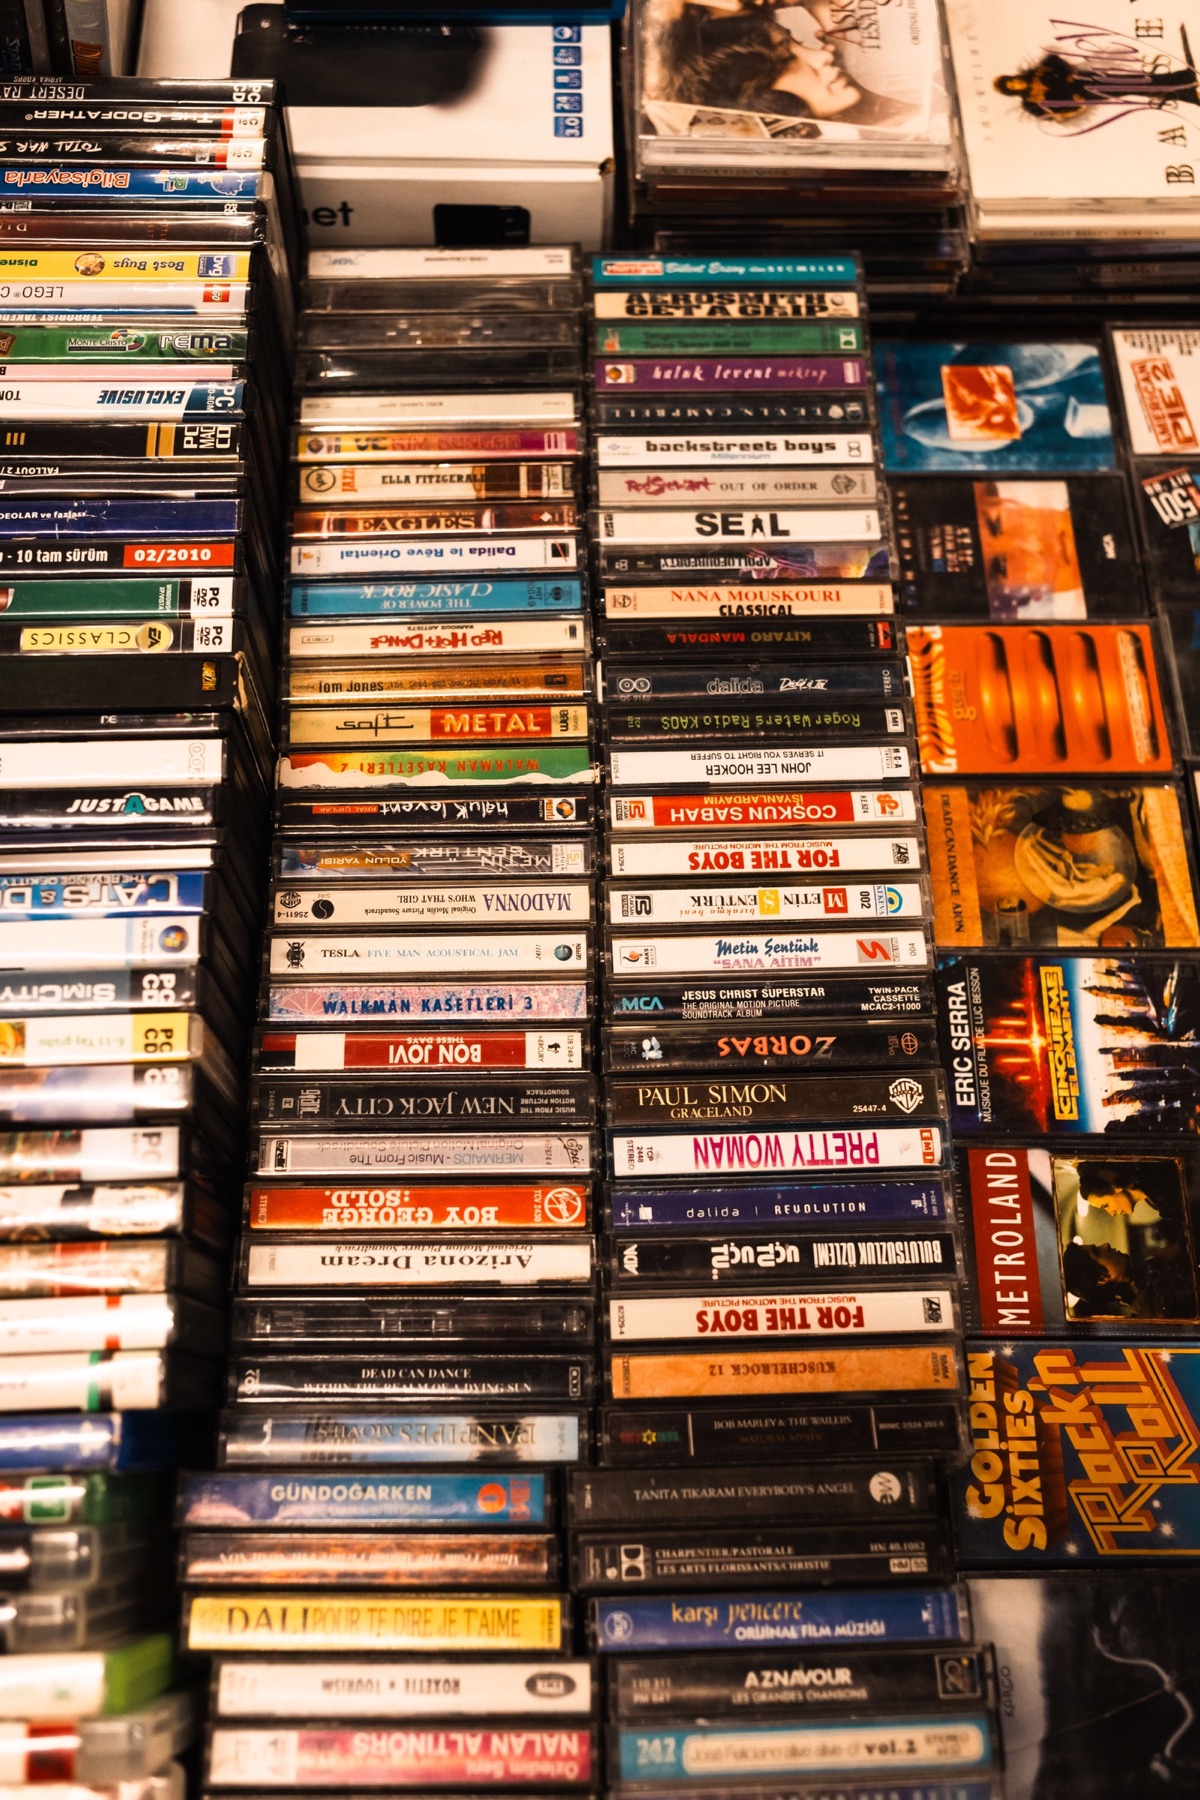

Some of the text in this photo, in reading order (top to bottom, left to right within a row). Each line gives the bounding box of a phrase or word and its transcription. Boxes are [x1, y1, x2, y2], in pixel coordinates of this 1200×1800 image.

[17, 141, 102, 153] TOTAL WAR
[4, 169, 131, 188] Bilgisayarla
[113, 260, 185, 272] Best Buys
[625, 292, 827, 306] AEROSMITH
[160, 334, 231, 350] rema
[97, 390, 186, 404] EXCLUSIVE
[215, 386, 236, 408] PC
[1157, 389, 1194, 445] PIE
[183, 426, 200, 449] PC
[215, 426, 231, 449] CD
[645, 439, 837, 454] backstreet boys
[1151, 490, 1200, 526] 501
[356, 516, 476, 532] EAGLES
[17, 550, 33, 563] 10
[36, 549, 62, 563] tam
[66, 549, 108, 563] sürüm
[134, 549, 212, 563] 02/2010
[340, 546, 516, 560] Dalida le Rêve Oriental
[208, 587, 220, 607] PC
[380, 599, 473, 609] THE POWER OF
[671, 589, 842, 602] NANA MOUSKOURI
[719, 604, 795, 617] CLASSICAL
[31, 631, 131, 645] CLASSICS
[148, 627, 162, 649] EA
[212, 626, 223, 646] PC
[666, 630, 812, 644] KITARO MANDALA
[318, 679, 384, 693] Tom Jones
[335, 712, 542, 737] soft METAL
[661, 712, 861, 730] Roger Waters Radio KAOS
[690, 750, 825, 761] IT SERVES YOU RIGHT TO SUFFER
[705, 761, 812, 776] JOHN LEE HOOKER
[670, 803, 837, 823] COŞKUN SABAH
[321, 856, 408, 867] YOLUN YARISI
[688, 848, 841, 871] FOR THE BOYS
[941, 793, 965, 934] DEAD CAN DANCE AION
[60, 874, 121, 886] REVENGE
[397, 894, 477, 904] WHO'S THAT GIRL
[482, 893, 572, 912] MADONNA
[860, 890, 871, 909] 002
[321, 946, 519, 959] TESLA FIVE MAN ACOUSTICAL JAM
[714, 938, 758, 956] Metin
[142, 973, 159, 1004] CD
[158, 973, 176, 1004] PC
[682, 987, 825, 1001] JESUS CHRIST SUPERSTAR
[970, 967, 982, 1004] BESSON
[321, 995, 533, 1015] WALKMAN KASETLERİ 3
[682, 1008, 763, 1019] SOUNDTRACK ALBUM
[973, 1004, 984, 1026] LUC
[161, 1028, 174, 1053] PC
[975, 1026, 985, 1040] DE
[716, 1035, 838, 1059] ZORBAS
[947, 980, 977, 1107] ERIC SERRA
[388, 1044, 482, 1064] BON JOVI
[979, 1063, 989, 1077] DU
[336, 1091, 514, 1116] NEW JACK CITY
[637, 1084, 787, 1106] PAUL SIMON
[980, 1077, 993, 1123] MUSIQUE
[520, 1106, 576, 1114] MUSIC FROM THE
[670, 1105, 753, 1120] GRACELAND
[317, 1139, 523, 1153] Original Motion Picture Soundtrack
[693, 1132, 880, 1170] PRETTY WOMAN
[322, 1206, 499, 1225] BOY GEORGE
[686, 1202, 867, 1219] dalida REVOLUTION
[985, 1151, 1031, 1326] METROLAND
[321, 1254, 532, 1270] Arizona Dream
[695, 1306, 865, 1333] FOR THE BOYS
[361, 1368, 472, 1380] DEAD CAN DANCE
[708, 1361, 836, 1377] KUSCHELROCK 12
[965, 1352, 1006, 1520] GOLDEN
[271, 1482, 432, 1502] GÜNDOĞARKEN
[634, 1483, 856, 1501] TANITA TIKARAM EVERYBODY'S ANGEL
[744, 1667, 852, 1689] AZNAVOUR
[731, 1687, 869, 1705] LES GRANDES CHANSONS
